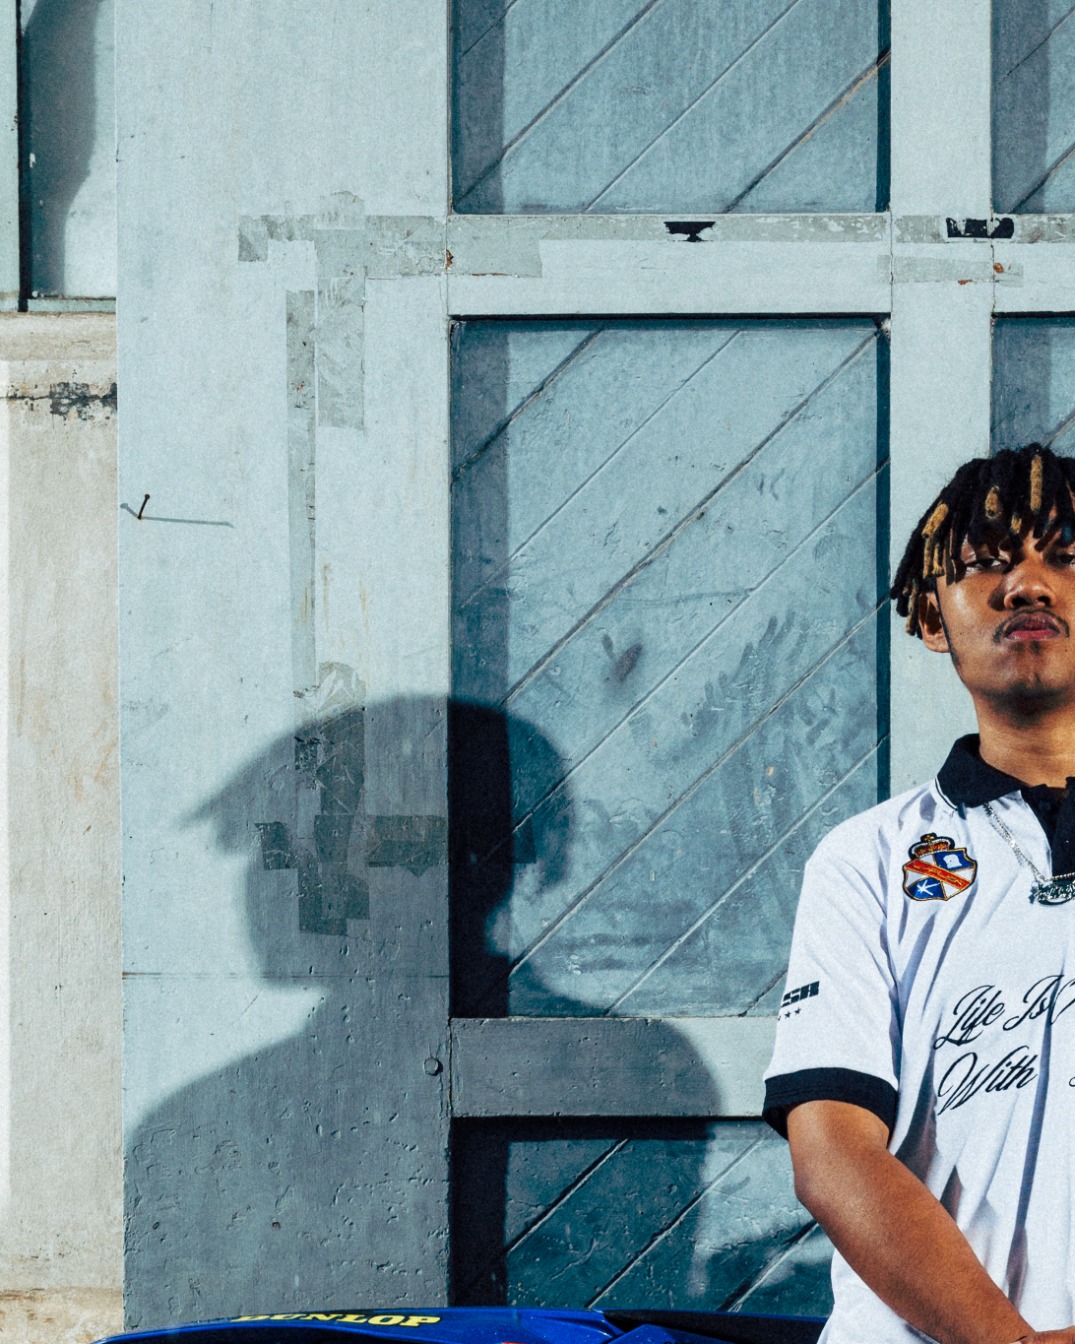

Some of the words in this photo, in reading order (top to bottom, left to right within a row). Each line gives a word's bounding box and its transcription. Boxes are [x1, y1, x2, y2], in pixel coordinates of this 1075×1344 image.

[933, 984, 1006, 1050] Life
[1002, 974, 1065, 1031] Is
[937, 1045, 1038, 1116] With
[230, 1313, 441, 1328] DUNLOP
